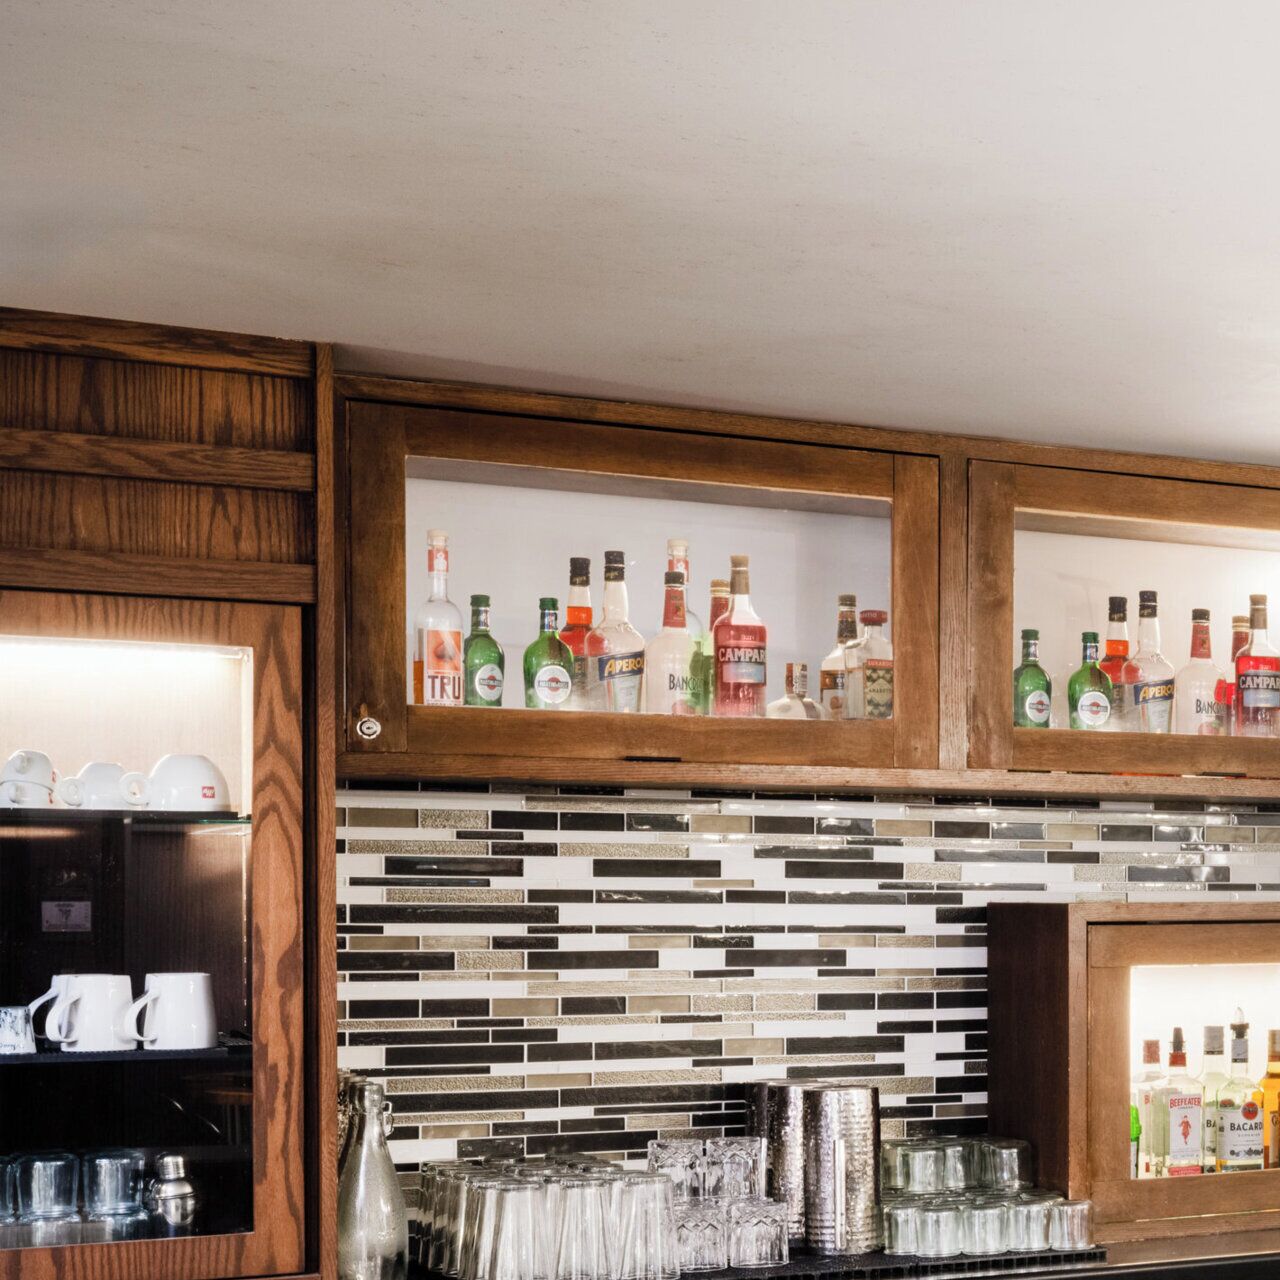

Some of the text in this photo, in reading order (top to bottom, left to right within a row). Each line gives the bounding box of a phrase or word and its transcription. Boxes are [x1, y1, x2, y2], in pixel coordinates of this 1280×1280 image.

[718, 647, 766, 662] CAMPAR
[1239, 675, 1280, 691] CAMPAR
[1169, 1097, 1201, 1109] BEEFEATER
[1230, 1122, 1263, 1131] BACARD
